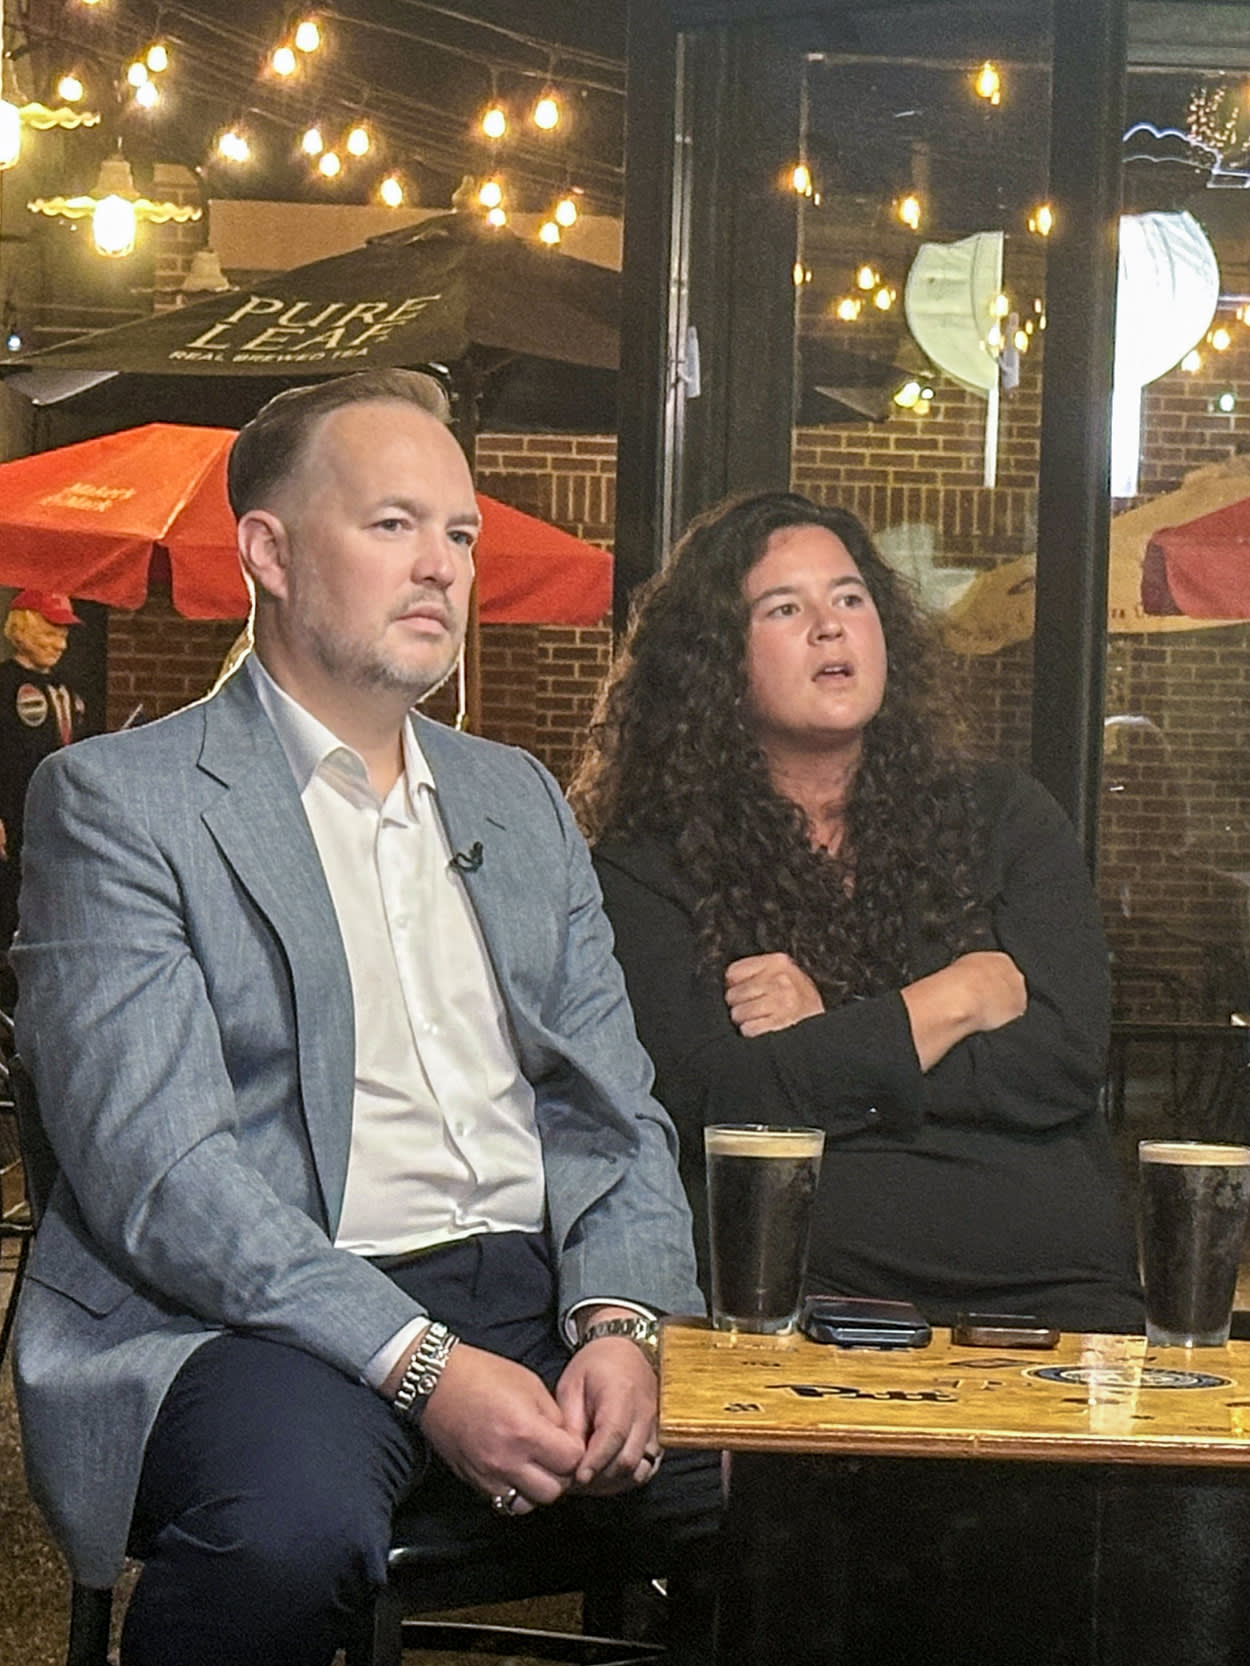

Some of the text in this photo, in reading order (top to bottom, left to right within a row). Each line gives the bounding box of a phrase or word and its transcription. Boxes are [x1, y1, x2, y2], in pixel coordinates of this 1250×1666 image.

[222, 293, 442, 327] PURE
[185, 321, 407, 351] LEAF
[168, 350, 225, 362] REAL
